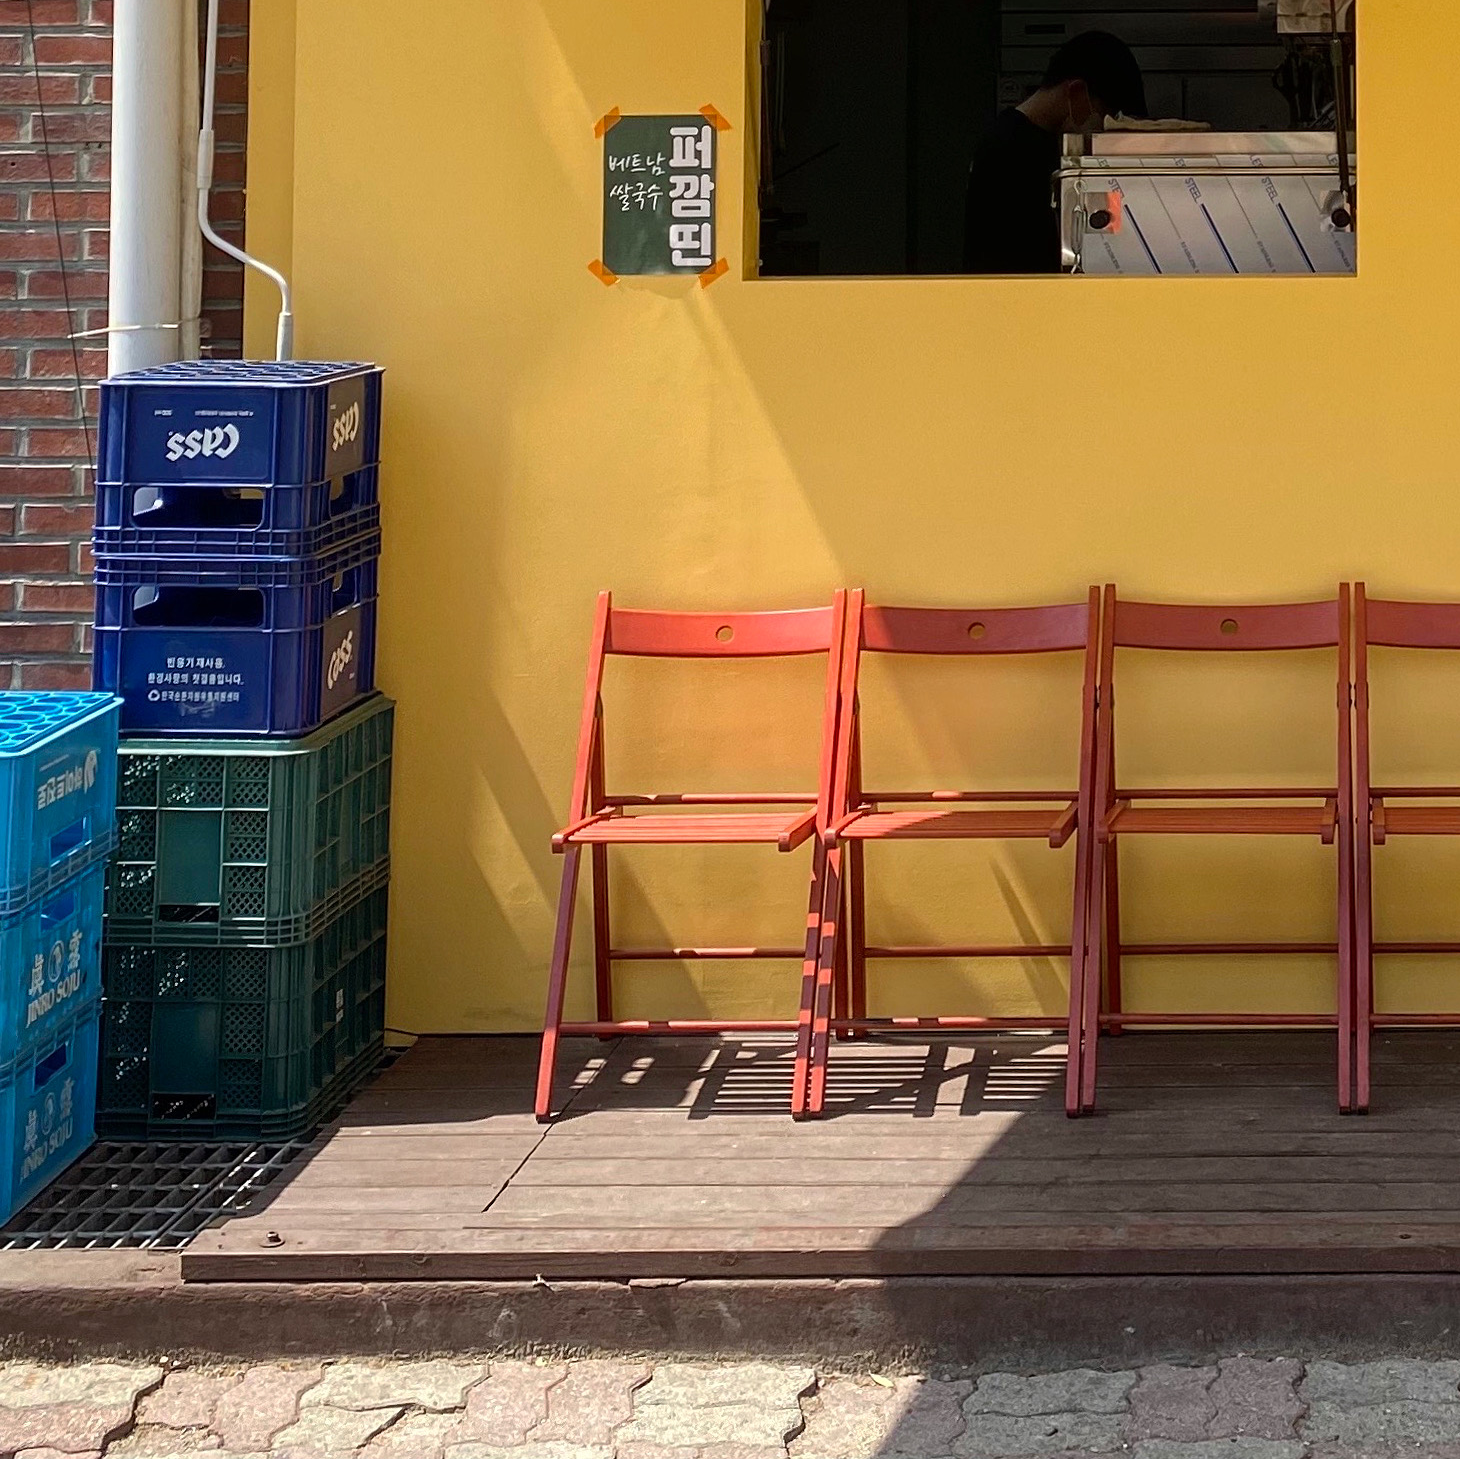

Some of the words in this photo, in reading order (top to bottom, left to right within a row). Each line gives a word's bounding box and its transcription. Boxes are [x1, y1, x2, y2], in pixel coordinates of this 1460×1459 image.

[608, 152, 666, 176] 베트남
[609, 182, 664, 212] 쌀국수
[669, 125, 714, 267] 퍼깜띤
